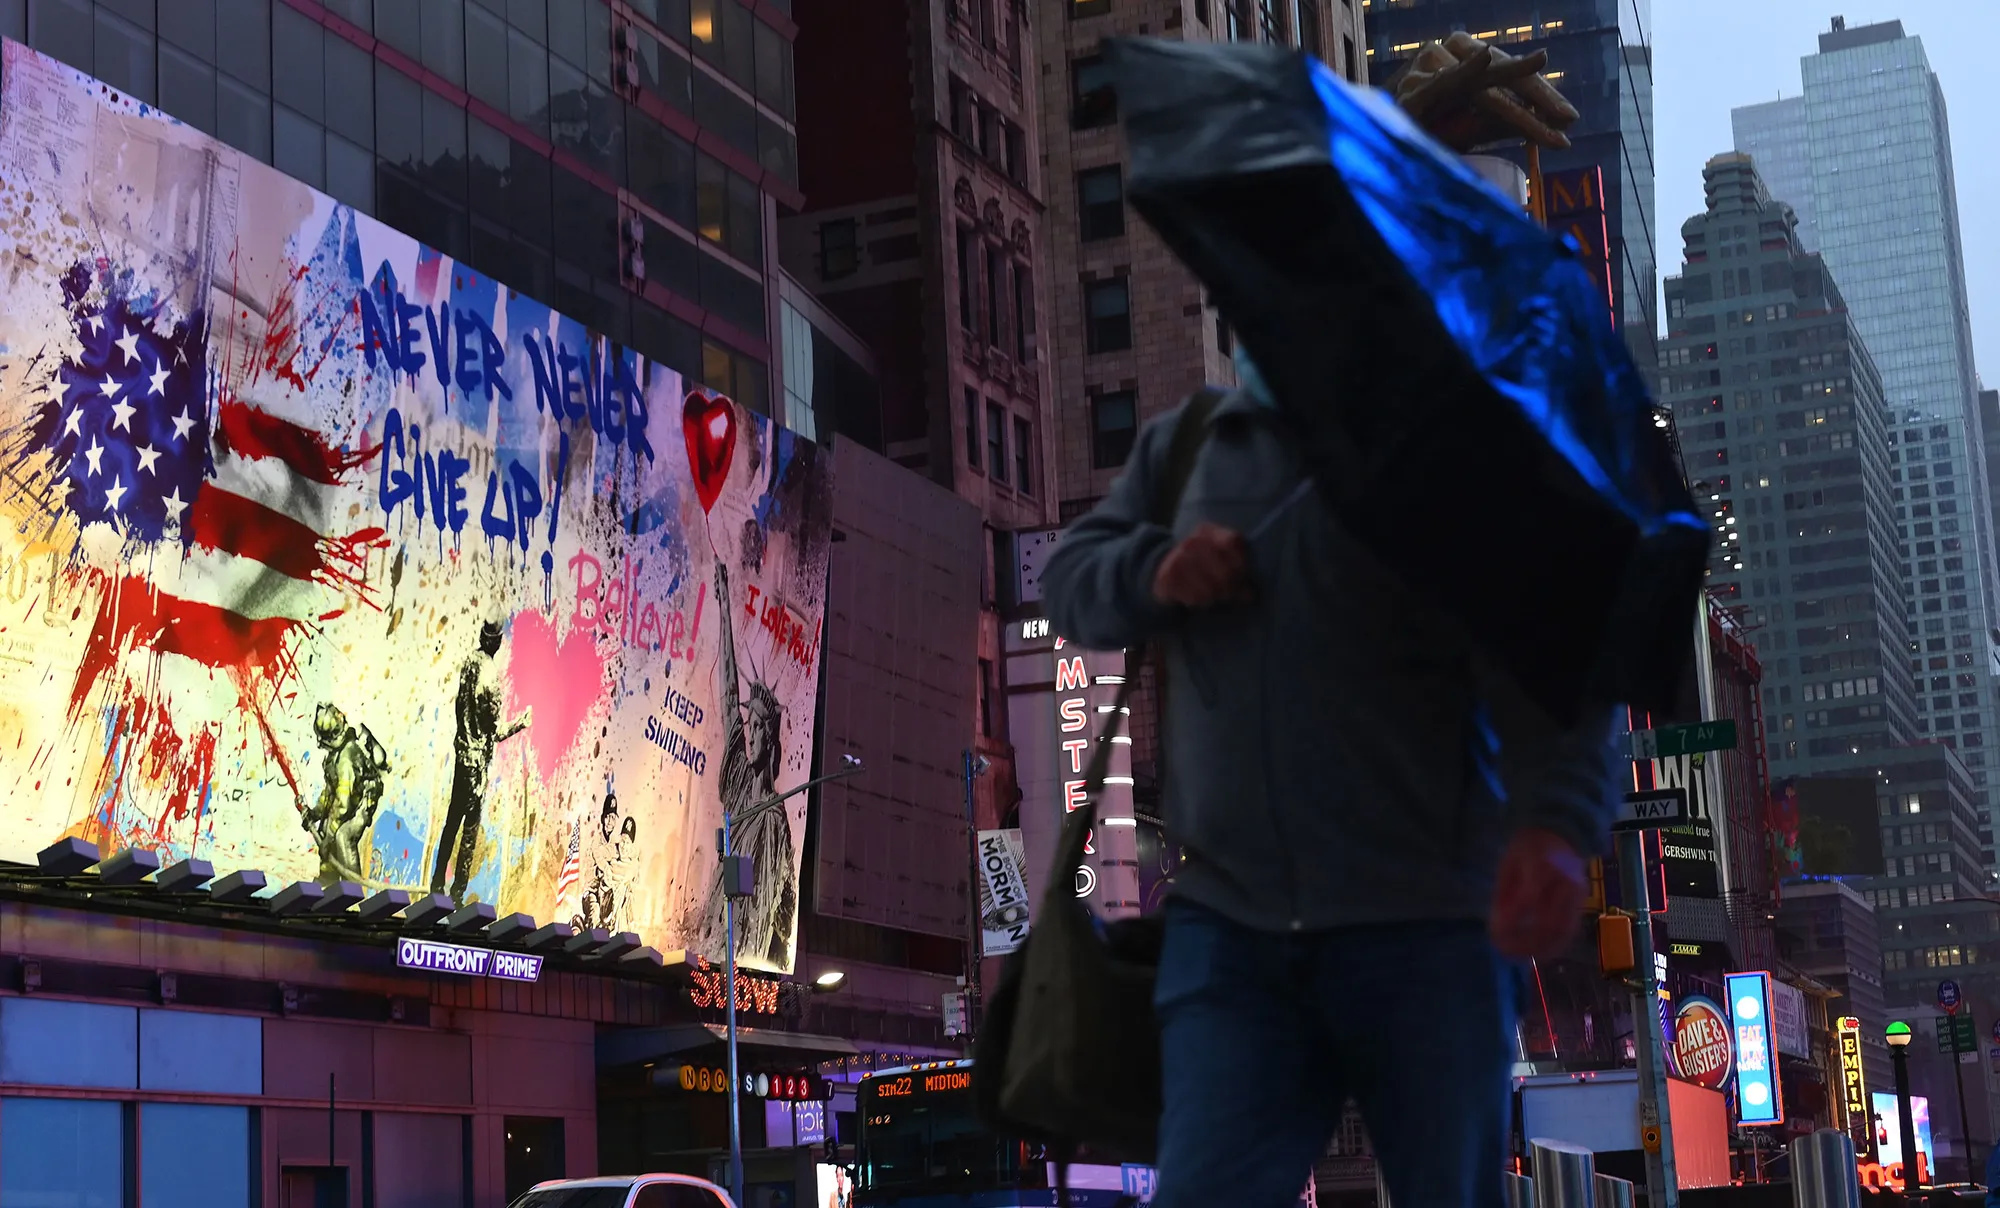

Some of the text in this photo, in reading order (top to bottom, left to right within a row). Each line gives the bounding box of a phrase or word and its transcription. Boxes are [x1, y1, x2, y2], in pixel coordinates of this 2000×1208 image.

[361, 288, 654, 463] NEVER NEVER
[745, 583, 760, 618] I
[760, 600, 790, 645] LOVE
[1022, 619, 1049, 639] NEW
[664, 685, 704, 729] KEEP
[644, 714, 707, 776] SMILING
[1677, 729, 1687, 750] 7
[1634, 800, 1671, 818] WAY
[1695, 826, 1710, 837] true
[1665, 845, 1707, 861] GERSHWIN
[402, 942, 538, 979] OUTFRONT PRIME
[1678, 1020, 1724, 1056] DAVE &
[1681, 1041, 1727, 1077] BUSTER'S
[745, 1074, 753, 1092] S
[1856, 1161, 1905, 1187] mc
